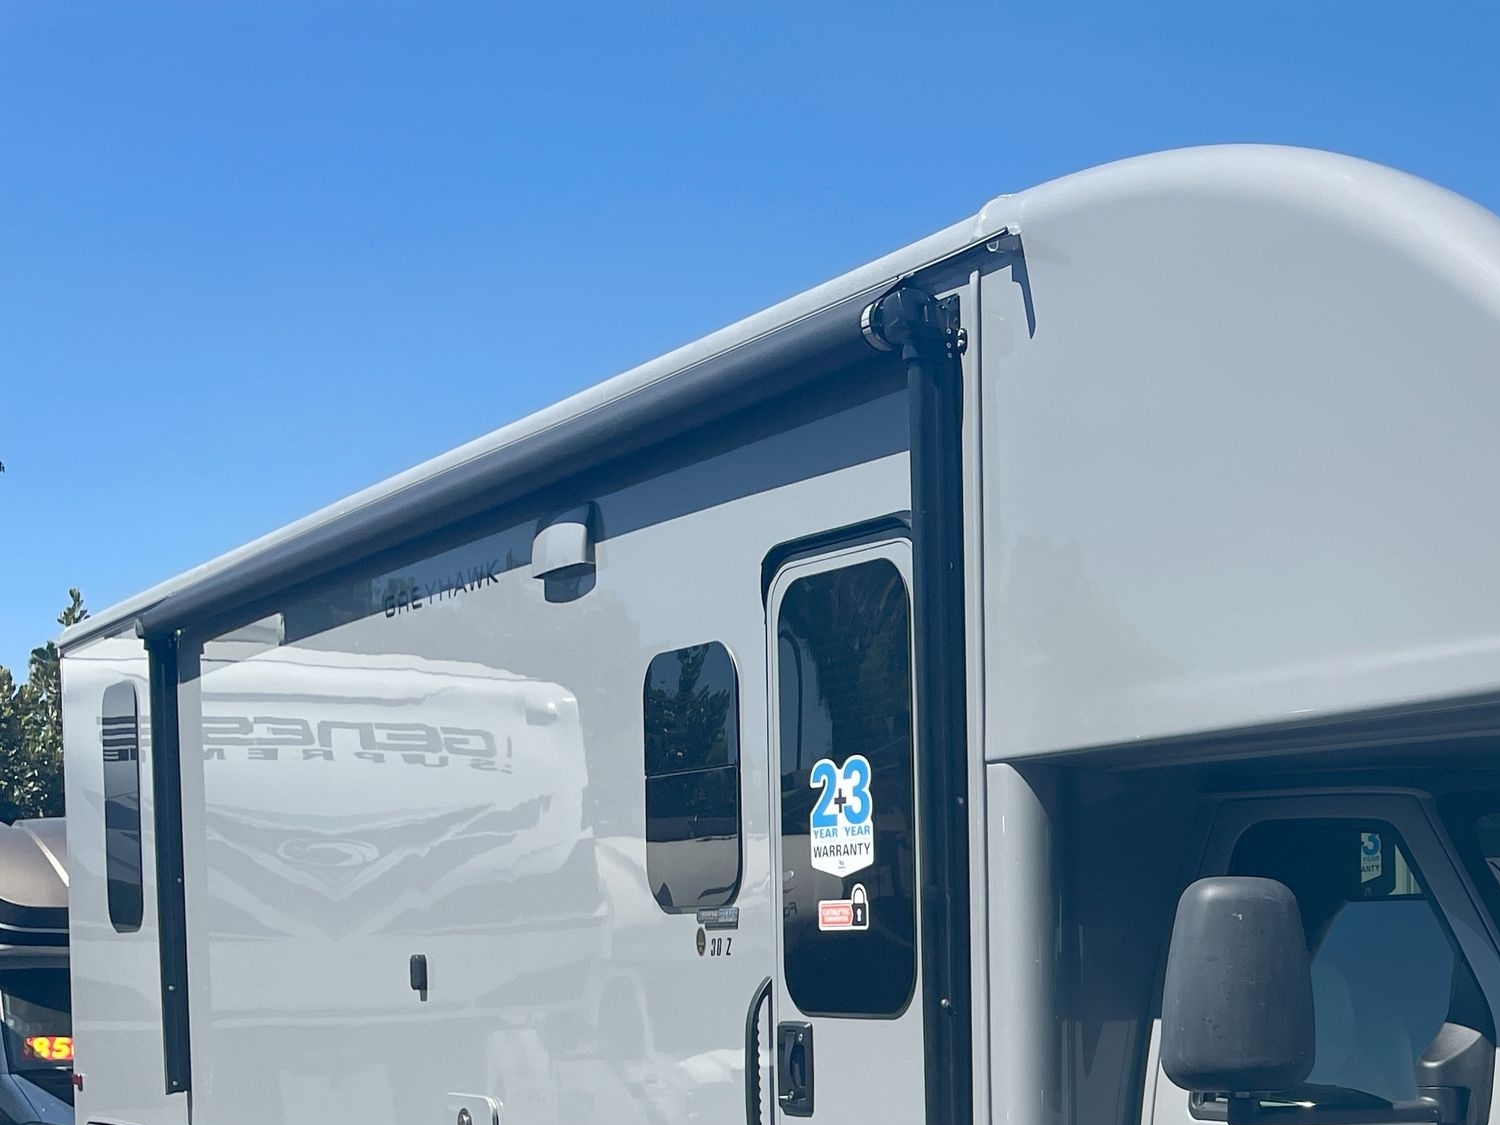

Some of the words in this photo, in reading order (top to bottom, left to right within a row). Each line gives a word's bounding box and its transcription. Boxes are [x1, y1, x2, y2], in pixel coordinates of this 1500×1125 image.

[813, 828, 838, 839] YEAR
[844, 826, 870, 837] YEAR
[813, 843, 871, 859] WARRANTY
[711, 938, 722, 956] 30
[726, 937, 732, 956] Z
